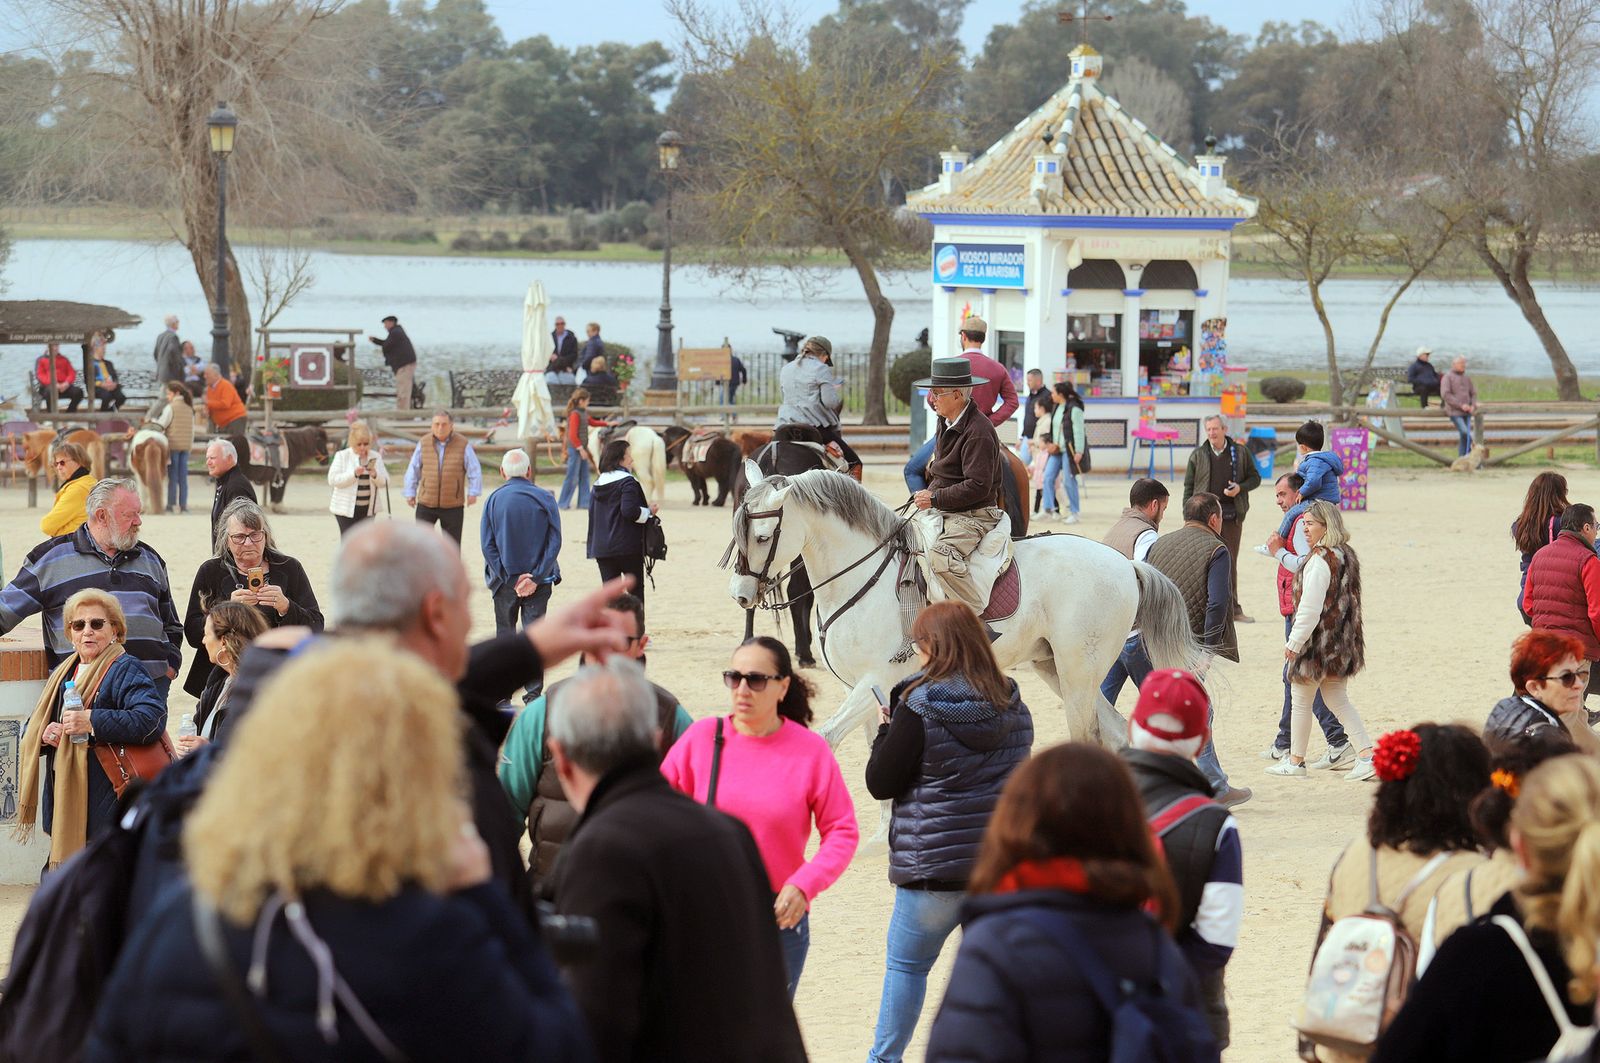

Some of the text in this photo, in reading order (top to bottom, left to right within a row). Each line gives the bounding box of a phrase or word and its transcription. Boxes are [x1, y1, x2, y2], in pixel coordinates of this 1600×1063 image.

[960, 251, 1024, 265] KIOSCO MIRADOR
[963, 264, 974, 276] DE
[975, 265, 984, 277] LA
[985, 265, 1020, 278] MARISMA
